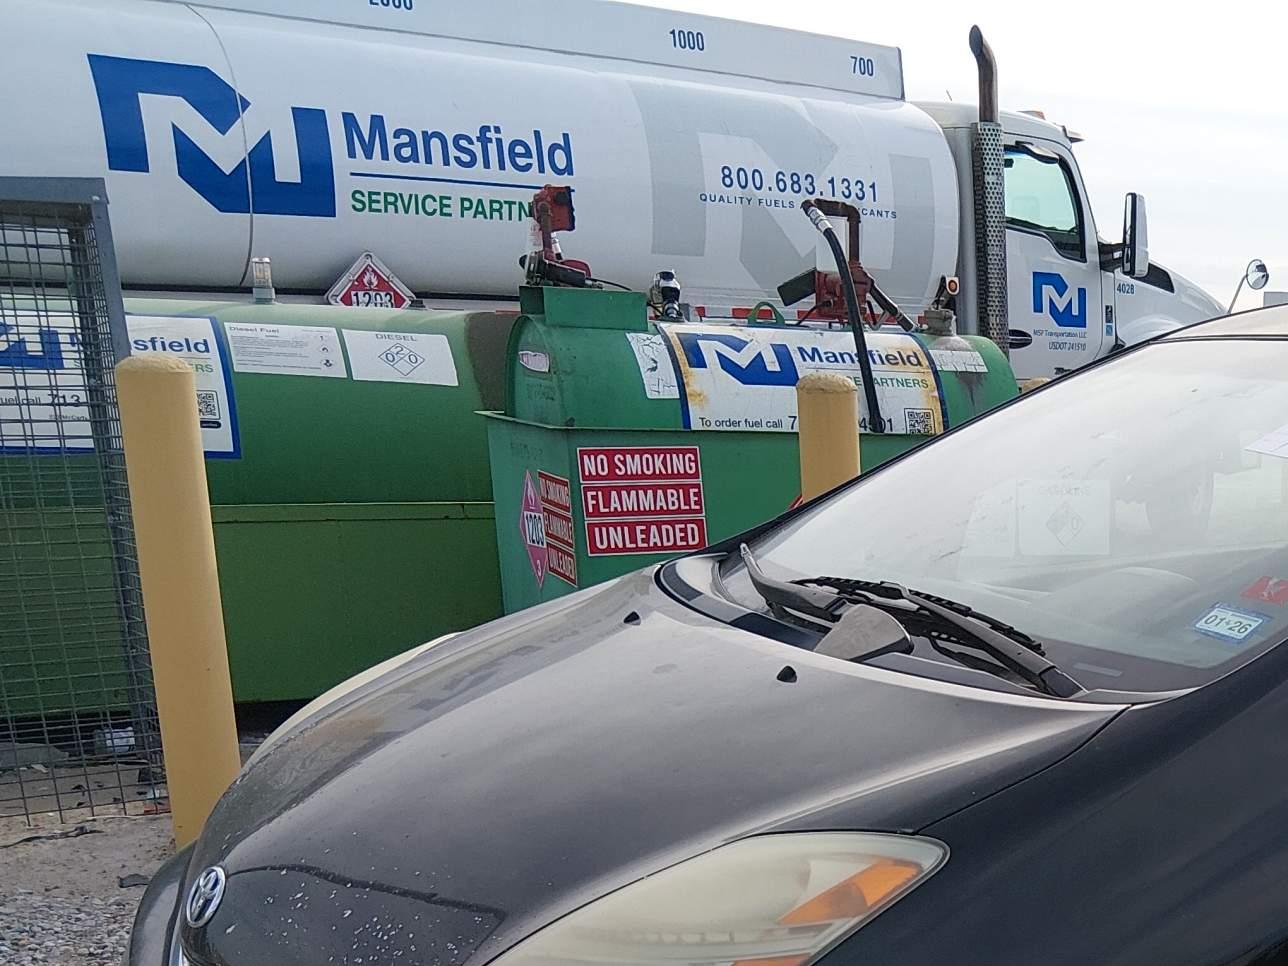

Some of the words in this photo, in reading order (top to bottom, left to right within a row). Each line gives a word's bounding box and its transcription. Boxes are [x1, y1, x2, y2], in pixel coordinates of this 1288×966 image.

[669, 29, 705, 52] 1000
[850, 56, 875, 77] 700
[342, 111, 575, 176] Mansfield
[721, 165, 877, 202] 800.683.1331
[351, 190, 453, 217] SERVICE
[460, 197, 533, 221] PARTN
[699, 193, 753, 206] QUALITY
[758, 198, 795, 208] FUELS
[861, 207, 897, 219] CANTS
[375, 333, 417, 342] DIESEL
[1048, 341, 1067, 350] USDOT
[872, 376, 929, 389] ARTNERS
[699, 417, 712, 427] To
[714, 418, 741, 428] order
[744, 418, 763, 428] fuel
[765, 419, 783, 429] call
[583, 454, 609, 476] NO
[614, 453, 696, 475] SMOKING
[586, 488, 701, 512] FLAMMABLE
[525, 512, 545, 547] 1203
[594, 523, 700, 549] UNLEADED
[536, 559, 542, 577] 3
